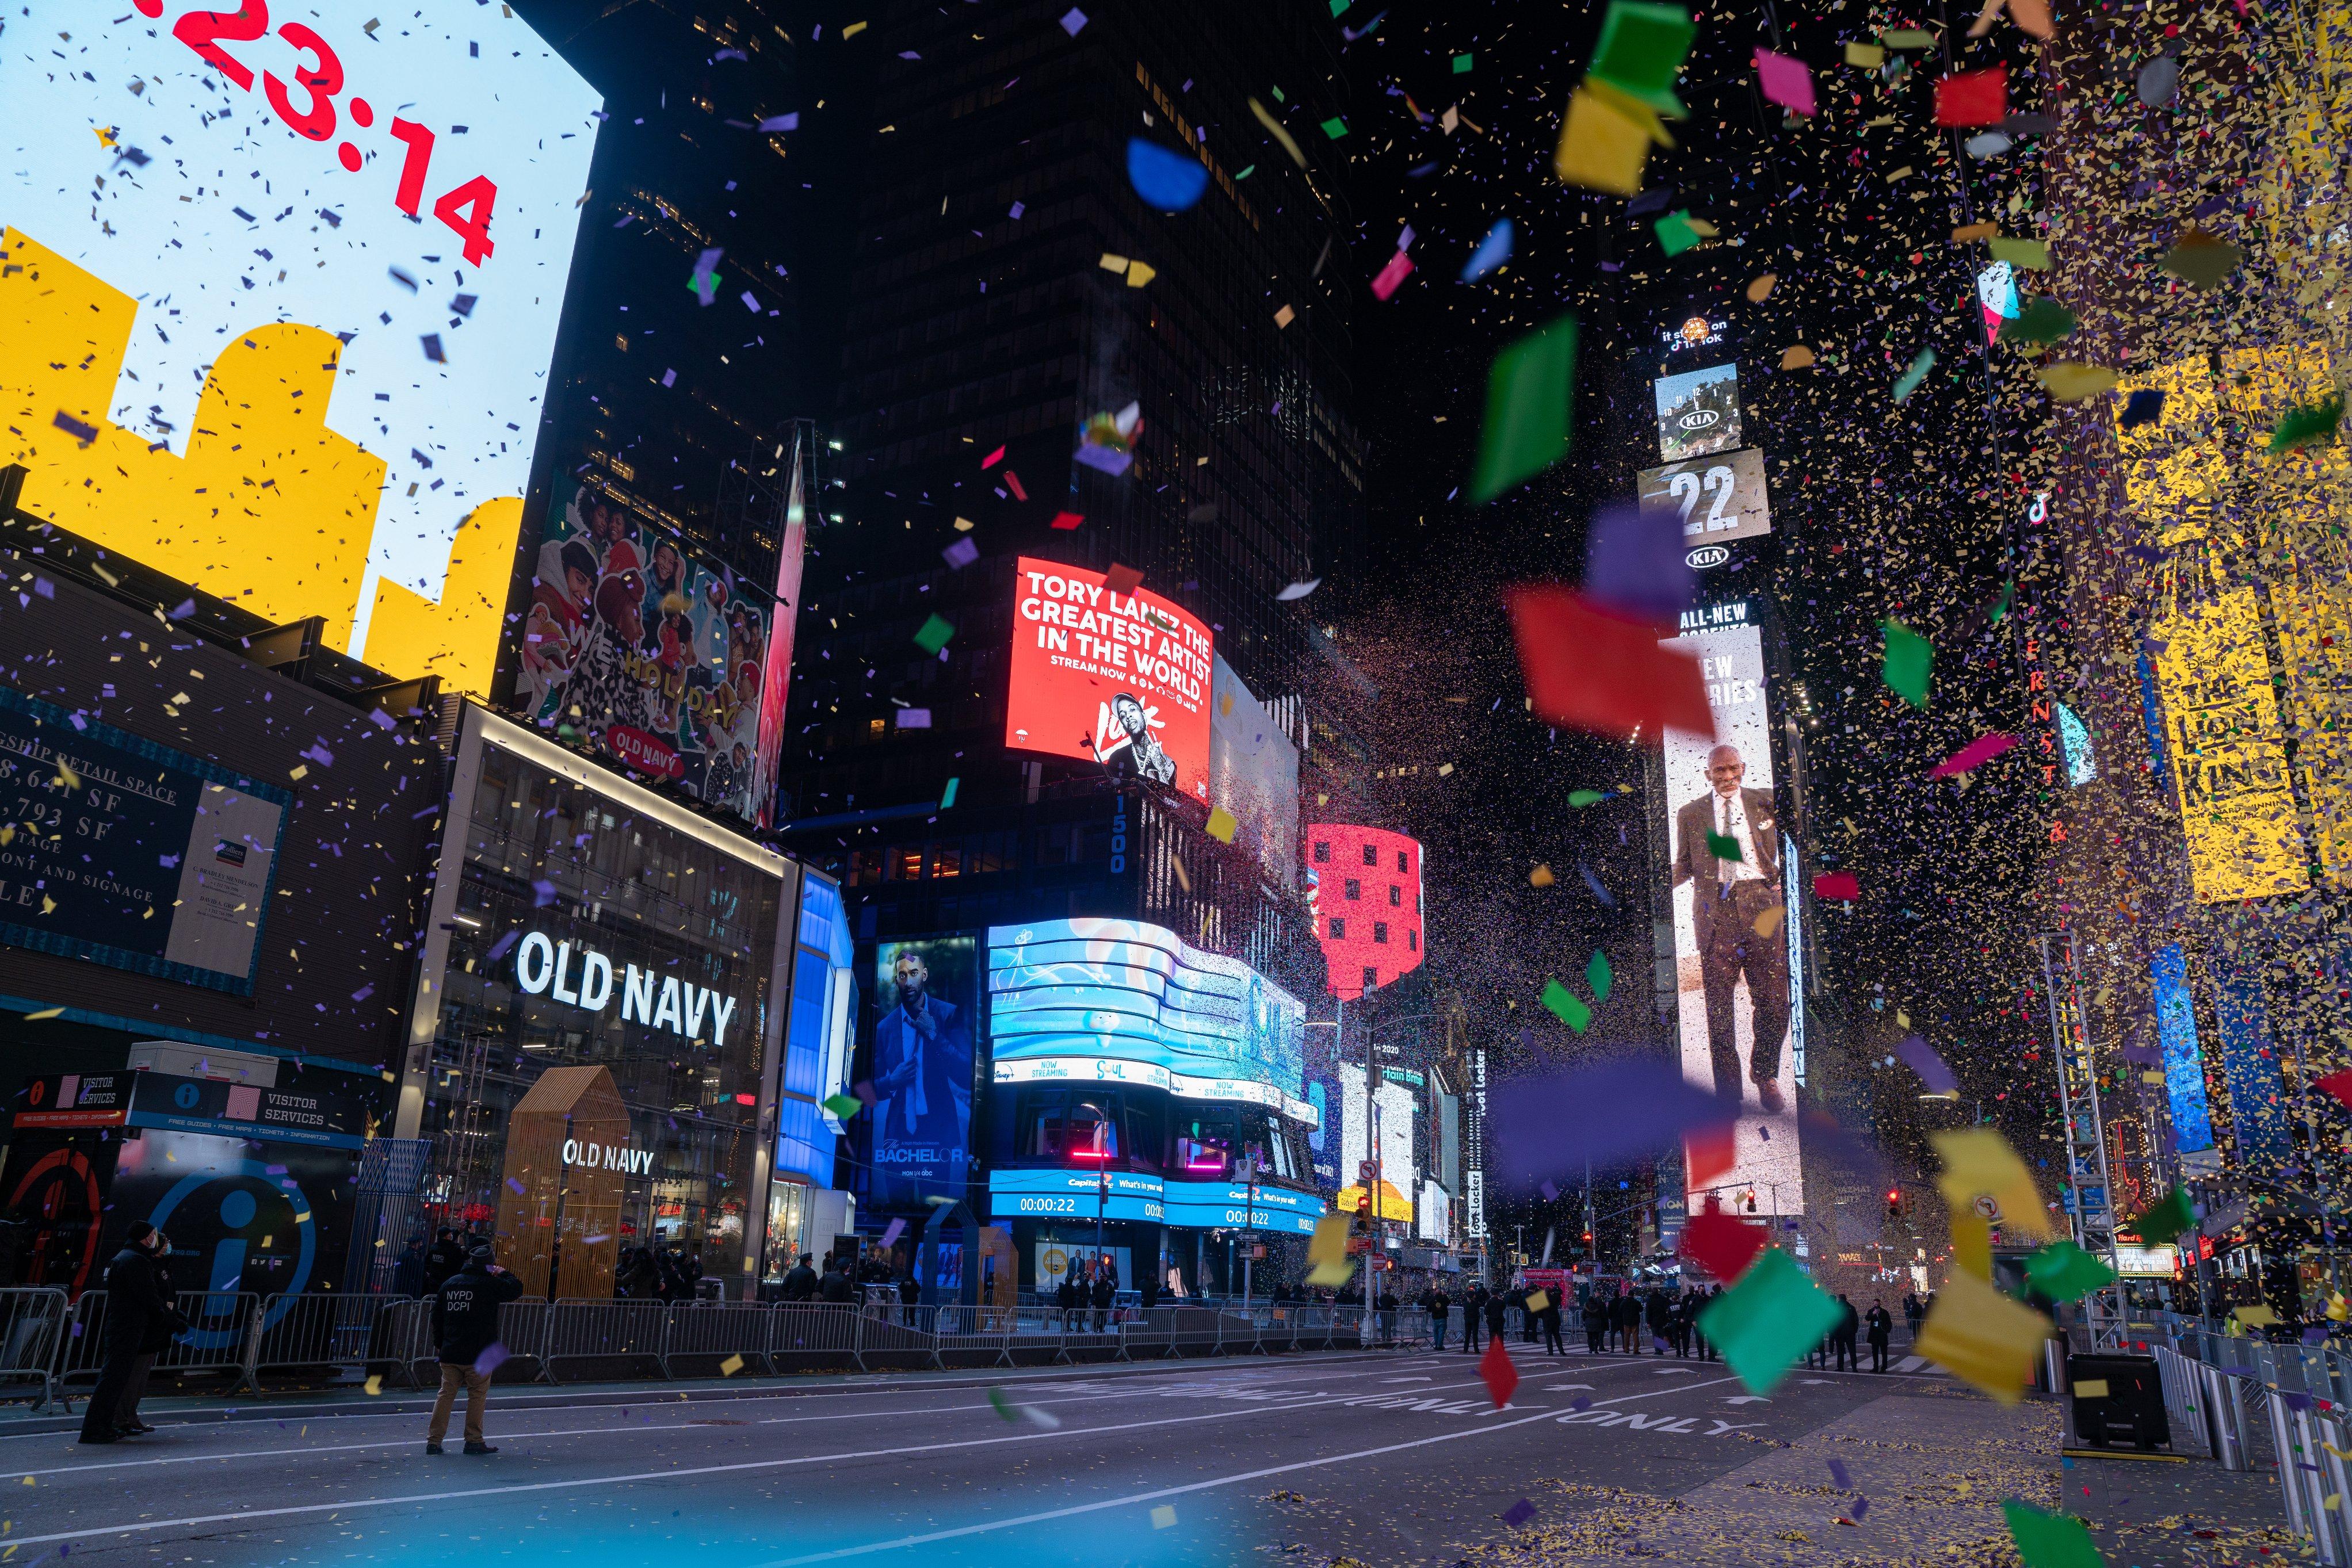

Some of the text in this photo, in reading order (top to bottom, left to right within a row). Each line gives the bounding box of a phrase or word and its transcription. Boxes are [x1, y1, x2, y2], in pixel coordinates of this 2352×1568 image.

[1711, 321, 1727, 331] on
[1683, 334, 1723, 349] Tok
[1675, 395, 1683, 404] 11
[1693, 387, 1701, 397] 12
[1726, 395, 1731, 405] 2
[1664, 407, 1673, 418] 10
[1686, 412, 1713, 427] KIA
[1733, 408, 1738, 418] 3
[1660, 422, 1666, 431] 9
[1669, 465, 1739, 537] 22
[1692, 548, 1723, 565] KIA
[1027, 571, 1210, 661] TORY LANEZ THE
[1679, 603, 1747, 629] ALL-NEW
[1021, 598, 1211, 686] GREATEST ARTIST
[568, 618, 739, 729] WE HOLIDAY
[1037, 625, 1203, 706] IN THE WORLD.
[1050, 655, 1126, 682] STREAM NOW
[1702, 655, 1733, 680] EW
[1709, 679, 1755, 707] RIES
[616, 732, 677, 772] OLD NAVY
[58, 751, 120, 785] RETAIL
[125, 776, 177, 804] SPACE
[87, 788, 121, 813] SF
[75, 816, 112, 842] SF
[1110, 794, 1127, 874] 1500
[16, 831, 62, 854] TAGE
[42, 865, 77, 881] AND
[82, 874, 153, 902] SIGNAGE
[518, 931, 736, 1047] OLD NAVY
[1382, 1045, 1399, 1054] 2020
[1032, 1060, 1068, 1079] NOW STREAMING
[1155, 1067, 1165, 1077] NOW
[1475, 1049, 1486, 1088] Locker
[82, 1076, 114, 1088] VISITOR
[1204, 1081, 1244, 1098] NOW STREAMING
[268, 1093, 318, 1109] VISITOR
[265, 1108, 324, 1125] SERVICES
[188, 1120, 212, 1129] GUIDES
[218, 1123, 234, 1131] FREE
[258, 1128, 285, 1136] TICKETS
[290, 1131, 330, 1141] INFORMATION
[563, 1139, 654, 1175] OLD NAVY
[875, 1148, 964, 1162] BACHELOR
[1068, 1179, 1101, 1187] Capital
[1119, 1179, 1156, 1192] What's in your
[1471, 1174, 1480, 1208] Locker
[1021, 1198, 1075, 1212] 00:00:22
[1228, 1191, 1261, 1202] Capit One
[2117, 1234, 2136, 1242] Hard
[446, 1290, 473, 1301] NYPD
[447, 1301, 470, 1311] DCPI
[1555, 1410, 1771, 1436] ONLY
